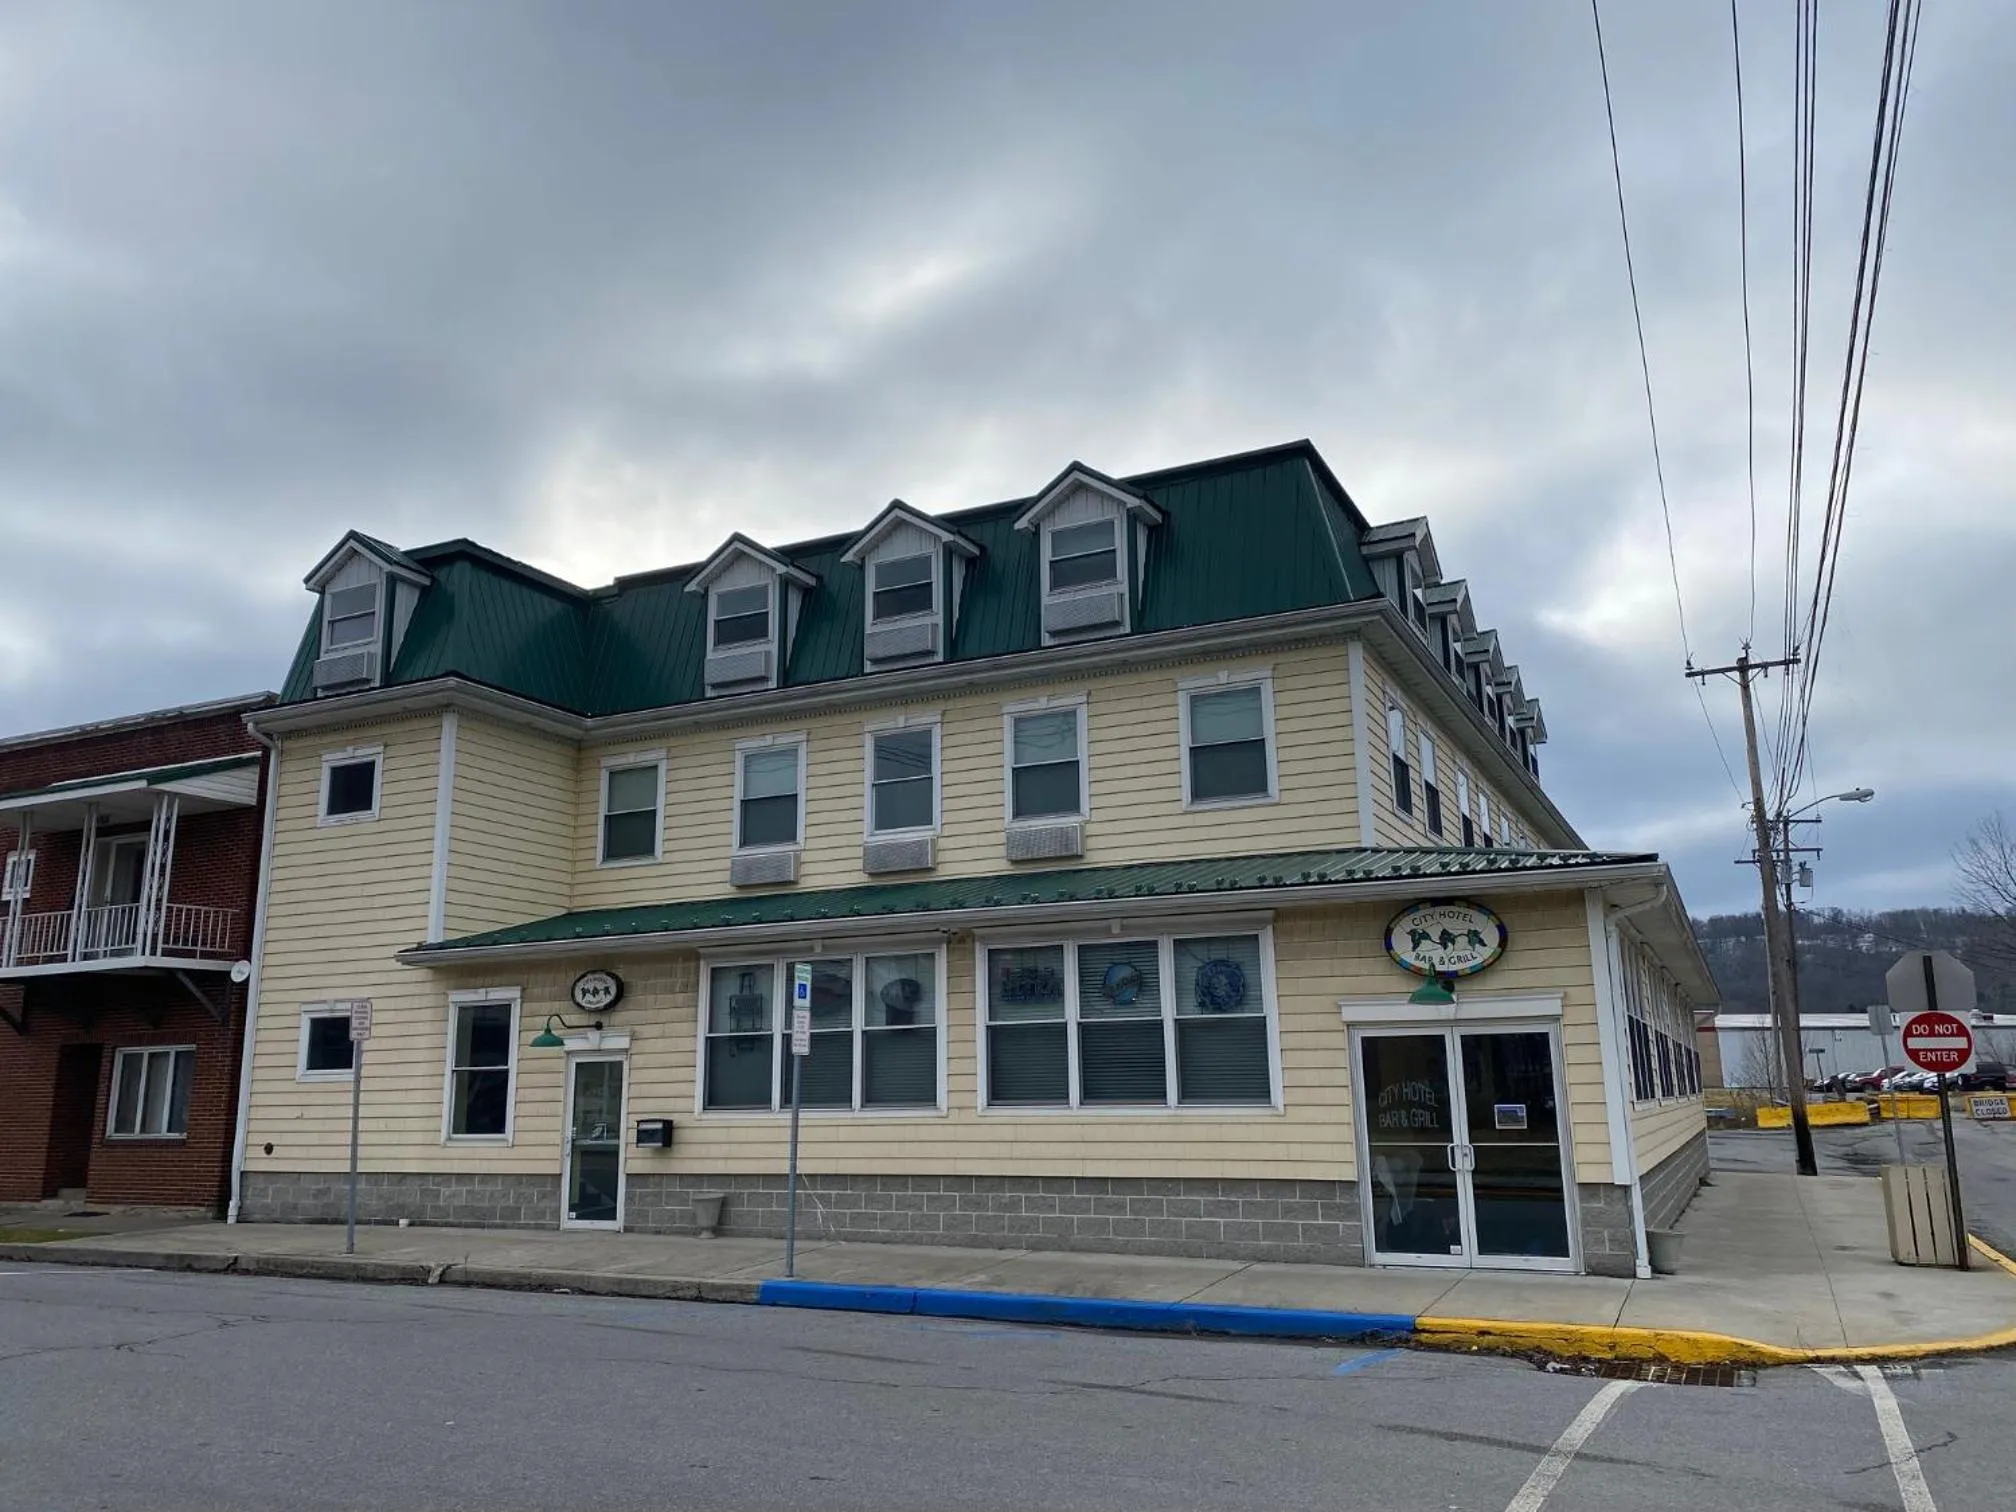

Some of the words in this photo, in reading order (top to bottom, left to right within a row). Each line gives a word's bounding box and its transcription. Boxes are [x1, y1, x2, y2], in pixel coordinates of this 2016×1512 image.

[1411, 912, 1435, 927] CITY
[1439, 910, 1475, 924] HOTEL
[1413, 952, 1434, 964] BAR
[1439, 955, 1446, 966] &
[1448, 951, 1479, 966] GRILL
[1912, 1024, 1929, 1035] DO
[1934, 1024, 1958, 1035] NOT
[1919, 1051, 1959, 1062] ENTER
[1378, 1083, 1400, 1108] CITY
[1402, 1080, 1440, 1108] HOTEL
[1379, 1109, 1400, 1129] BAR
[1410, 1108, 1440, 1129] GRILL
[1975, 1107, 2008, 1116] CLOSED
